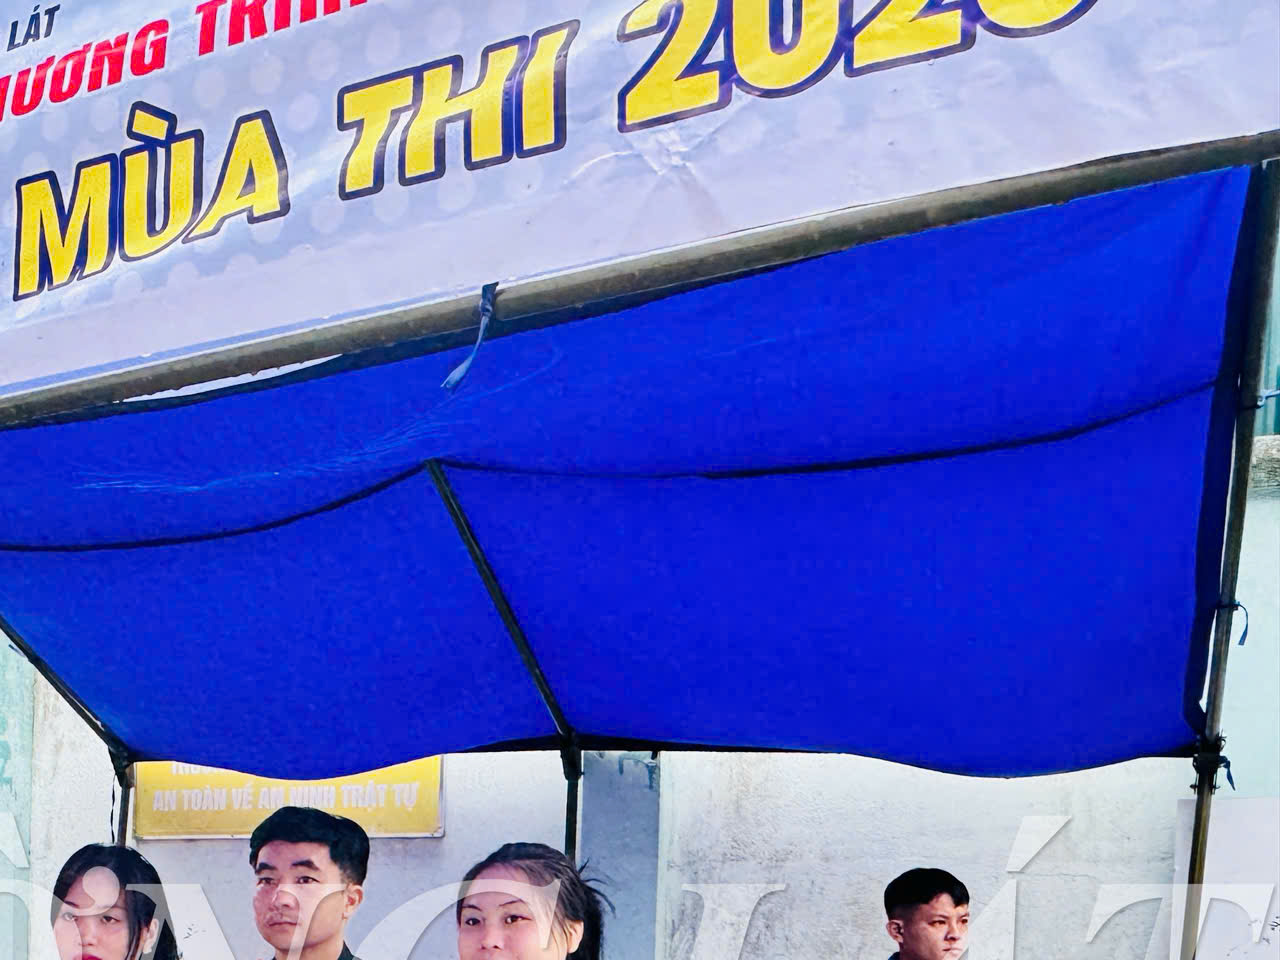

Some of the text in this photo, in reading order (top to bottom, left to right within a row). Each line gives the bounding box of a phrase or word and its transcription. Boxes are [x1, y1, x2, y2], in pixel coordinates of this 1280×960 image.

[6, 4, 61, 53] LÁT
[13, 101, 290, 302] MÙA
[337, 19, 580, 201] THI
[152, 789, 178, 812] AN
